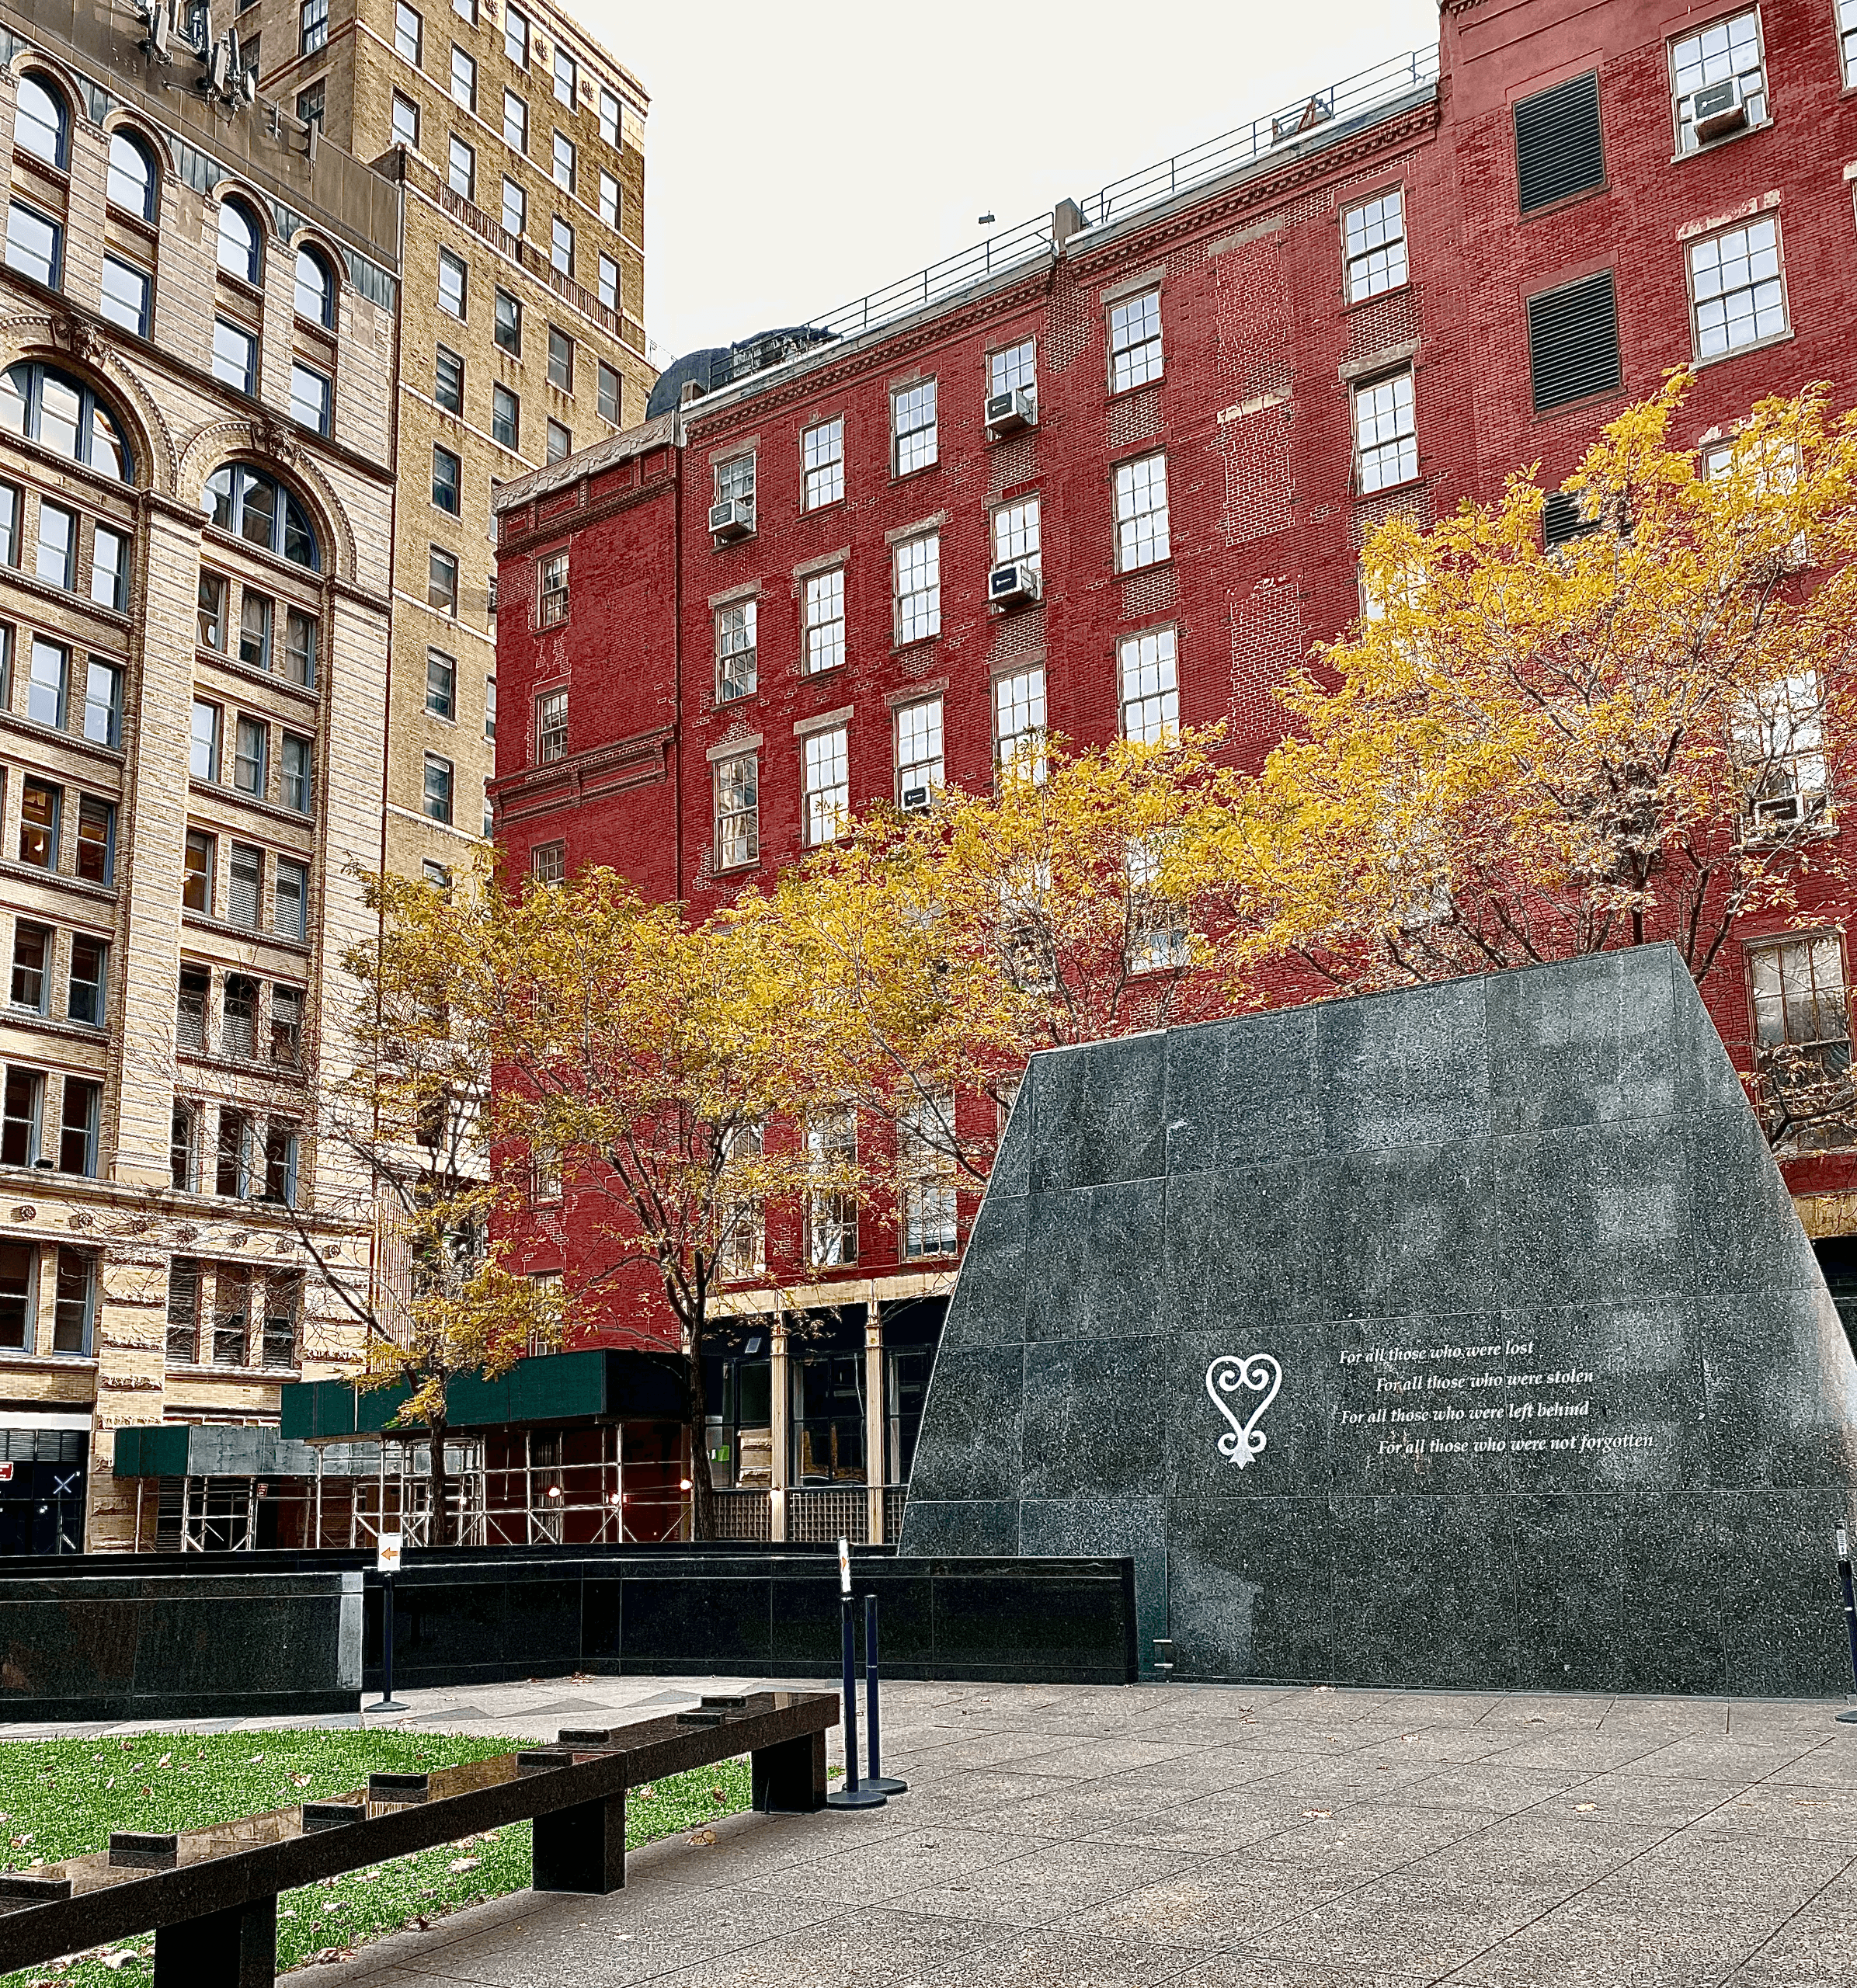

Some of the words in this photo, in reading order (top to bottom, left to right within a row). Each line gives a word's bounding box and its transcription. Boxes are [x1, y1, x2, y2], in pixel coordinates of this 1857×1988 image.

[1340, 1350, 1362, 1363] For
[1365, 1348, 1384, 1362] all
[1389, 1347, 1427, 1361] those
[1430, 1344, 1461, 1358] who
[1466, 1345, 1501, 1357] were
[1505, 1340, 1534, 1354] lost
[1375, 1378, 1401, 1392] For
[1403, 1375, 1423, 1390] all
[1427, 1375, 1466, 1389] those
[1470, 1372, 1503, 1387] who
[1507, 1373, 1542, 1385] were
[1546, 1369, 1594, 1384] stolen
[1341, 1410, 1365, 1424] For
[1367, 1409, 1387, 1423] all
[1391, 1408, 1429, 1422] those
[1433, 1406, 1464, 1420] who
[1469, 1406, 1504, 1420] were
[1508, 1402, 1534, 1421] left
[1537, 1400, 1590, 1416] behind
[1378, 1441, 1403, 1454] For
[1405, 1439, 1425, 1453] all
[1429, 1438, 1469, 1453] those
[1473, 1437, 1506, 1451] who
[1511, 1437, 1546, 1451] were
[1550, 1435, 1577, 1450] not
[1579, 1434, 1654, 1454] forgotten
